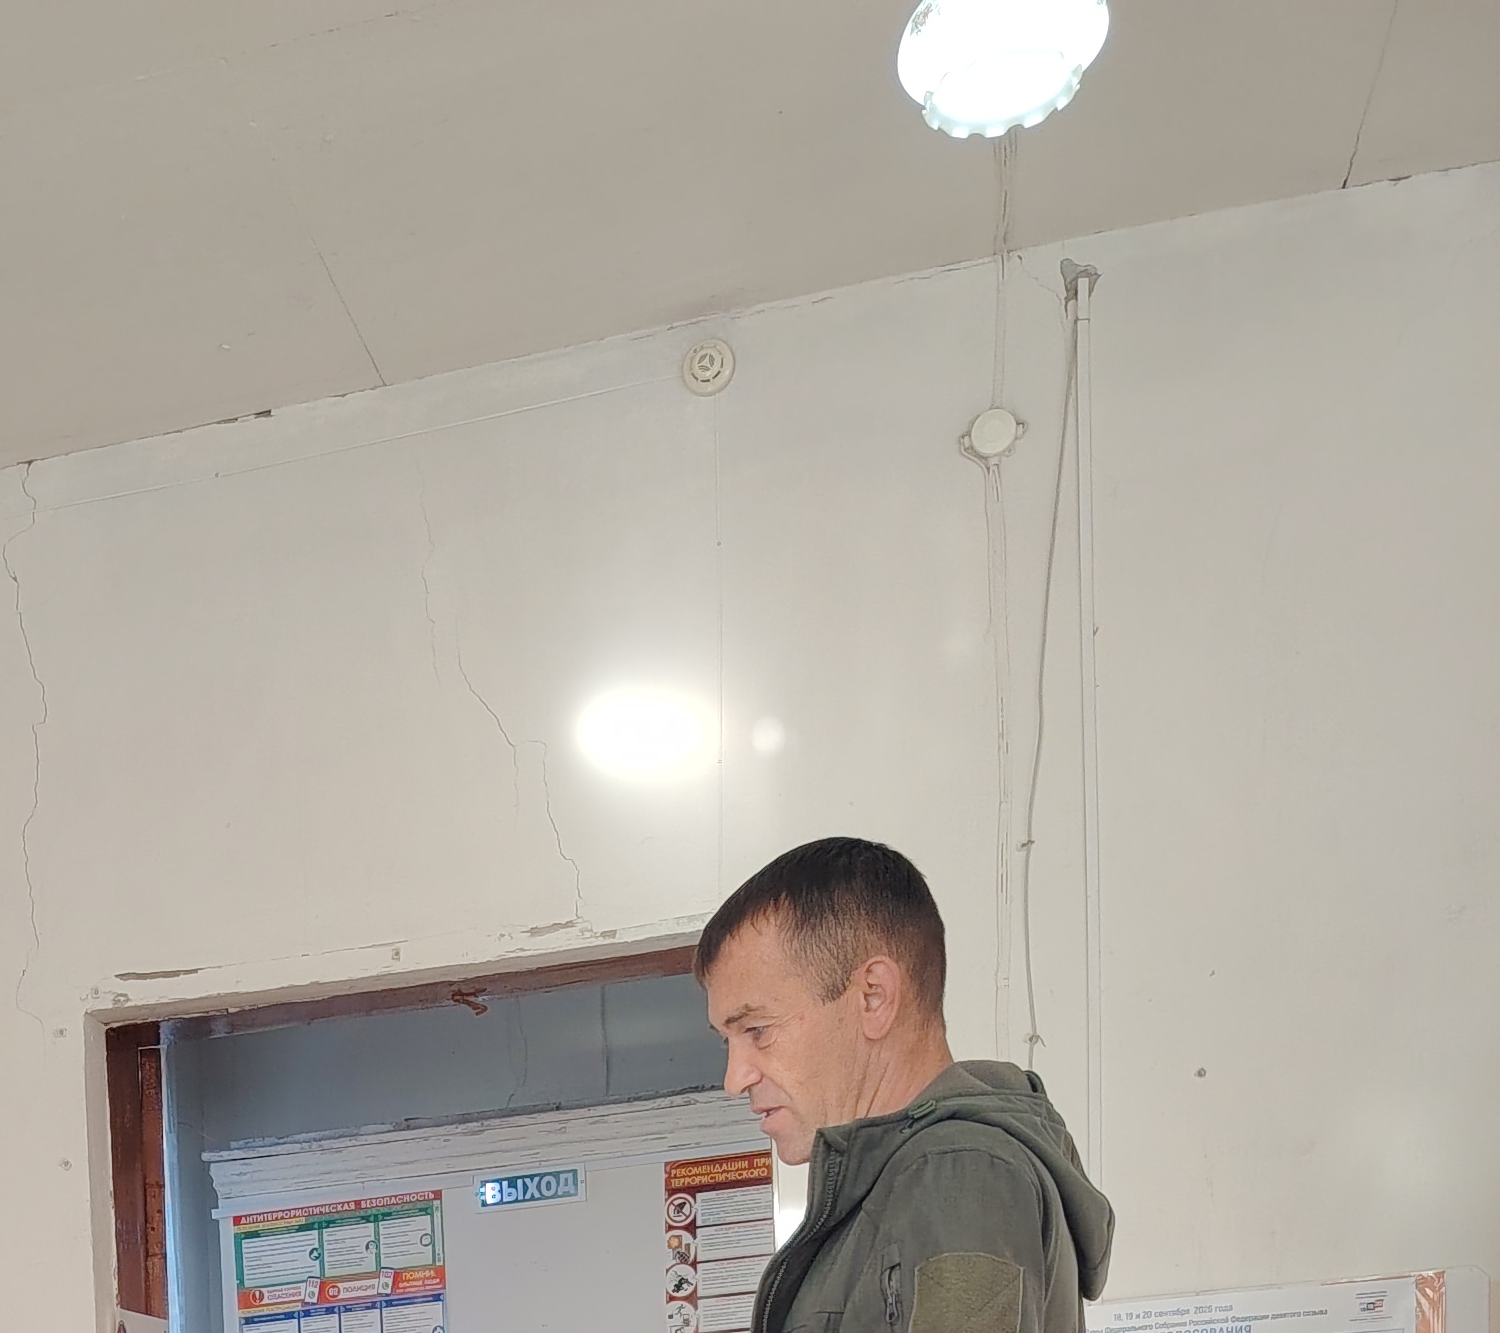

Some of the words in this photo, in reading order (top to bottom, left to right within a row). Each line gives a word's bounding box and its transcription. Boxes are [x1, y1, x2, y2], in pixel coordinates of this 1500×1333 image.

[671, 1161, 748, 1177] РЕКОМЕНДАЦИИ
[671, 1168, 768, 1187] ТЕРРОРИСТИЧЕСКОГО
[485, 1172, 575, 1204] ВЫХОД
[240, 1201, 355, 1224] АНТИТЕРРОРИСТИЧЕСКАЯ
[361, 1191, 435, 1209] БЕЗОПАСНОСТЬ
[1142, 1311, 1152, 1319] 20
